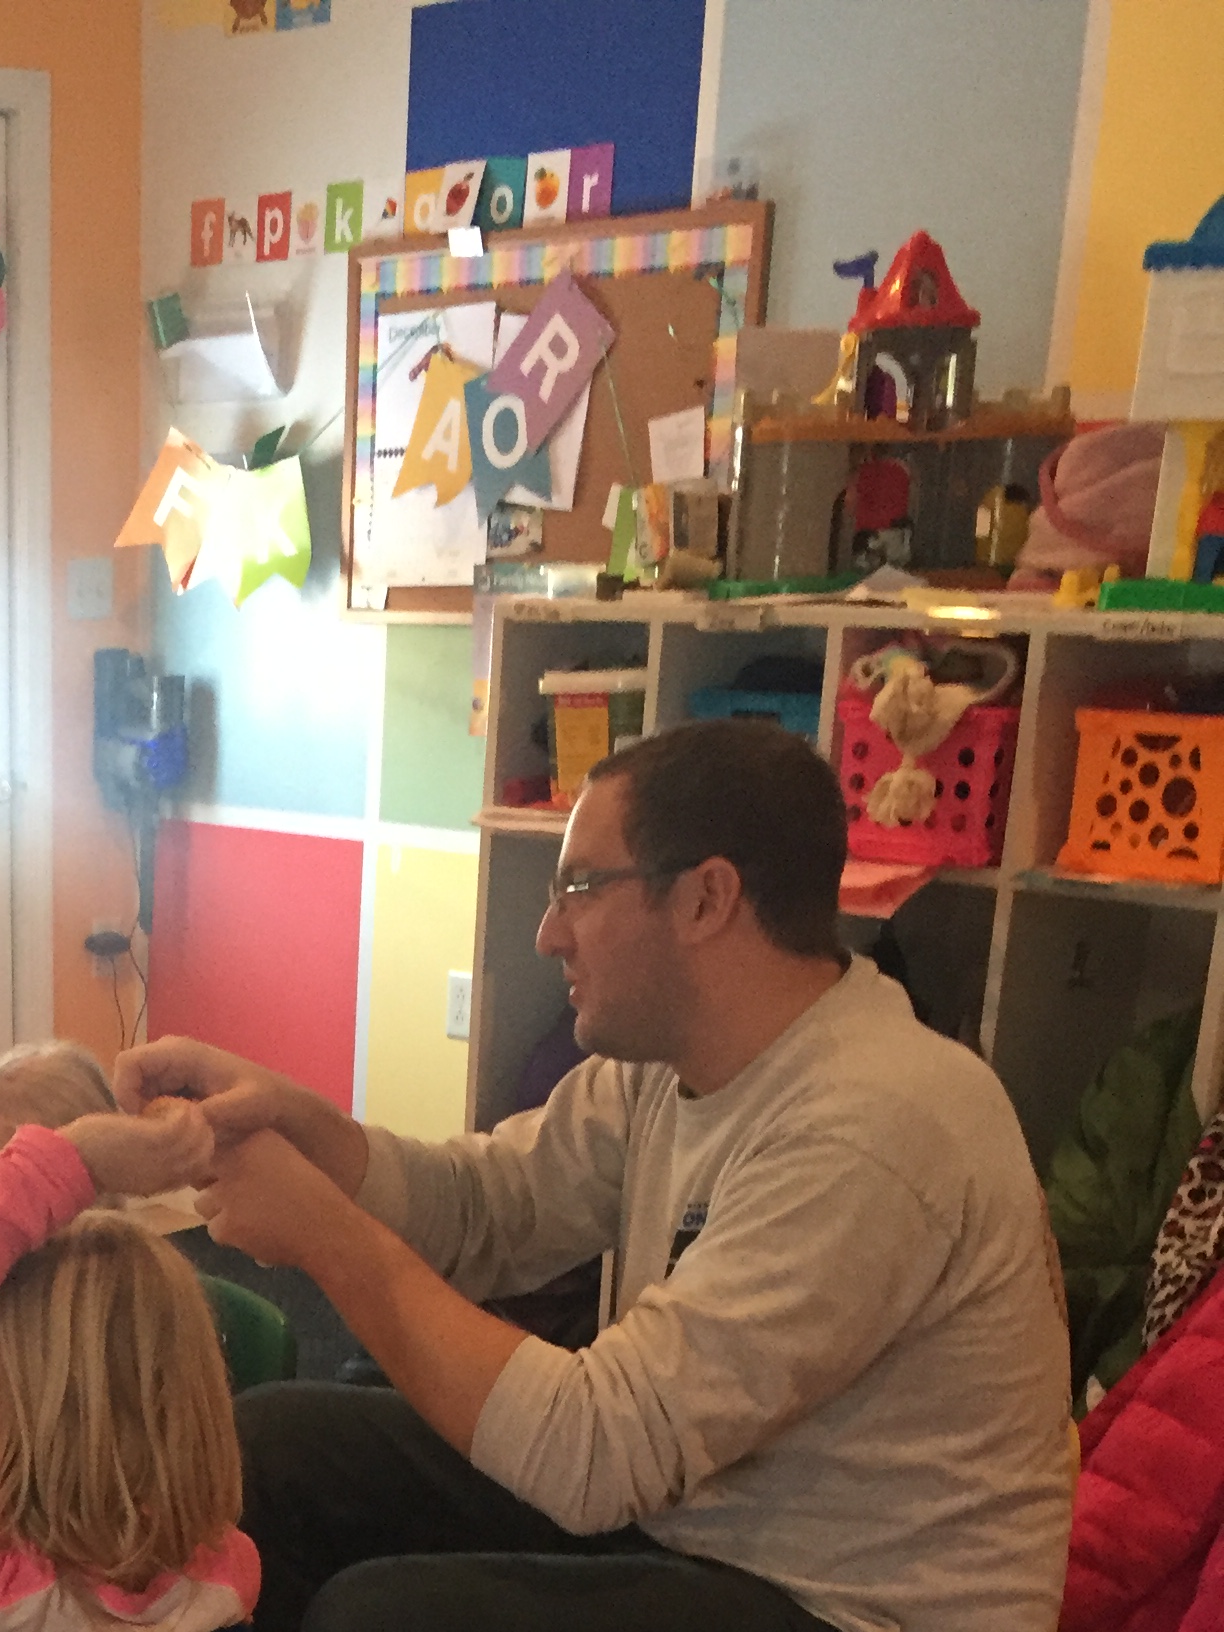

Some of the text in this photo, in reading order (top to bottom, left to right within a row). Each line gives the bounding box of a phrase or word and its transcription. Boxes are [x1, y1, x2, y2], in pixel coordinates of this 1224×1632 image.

[200, 211, 216, 257] f
[263, 206, 284, 256] p
[335, 198, 354, 244] k
[581, 171, 599, 214] r
[153, 466, 200, 527] F
[421, 396, 461, 473] A
[520, 313, 580, 404] R
